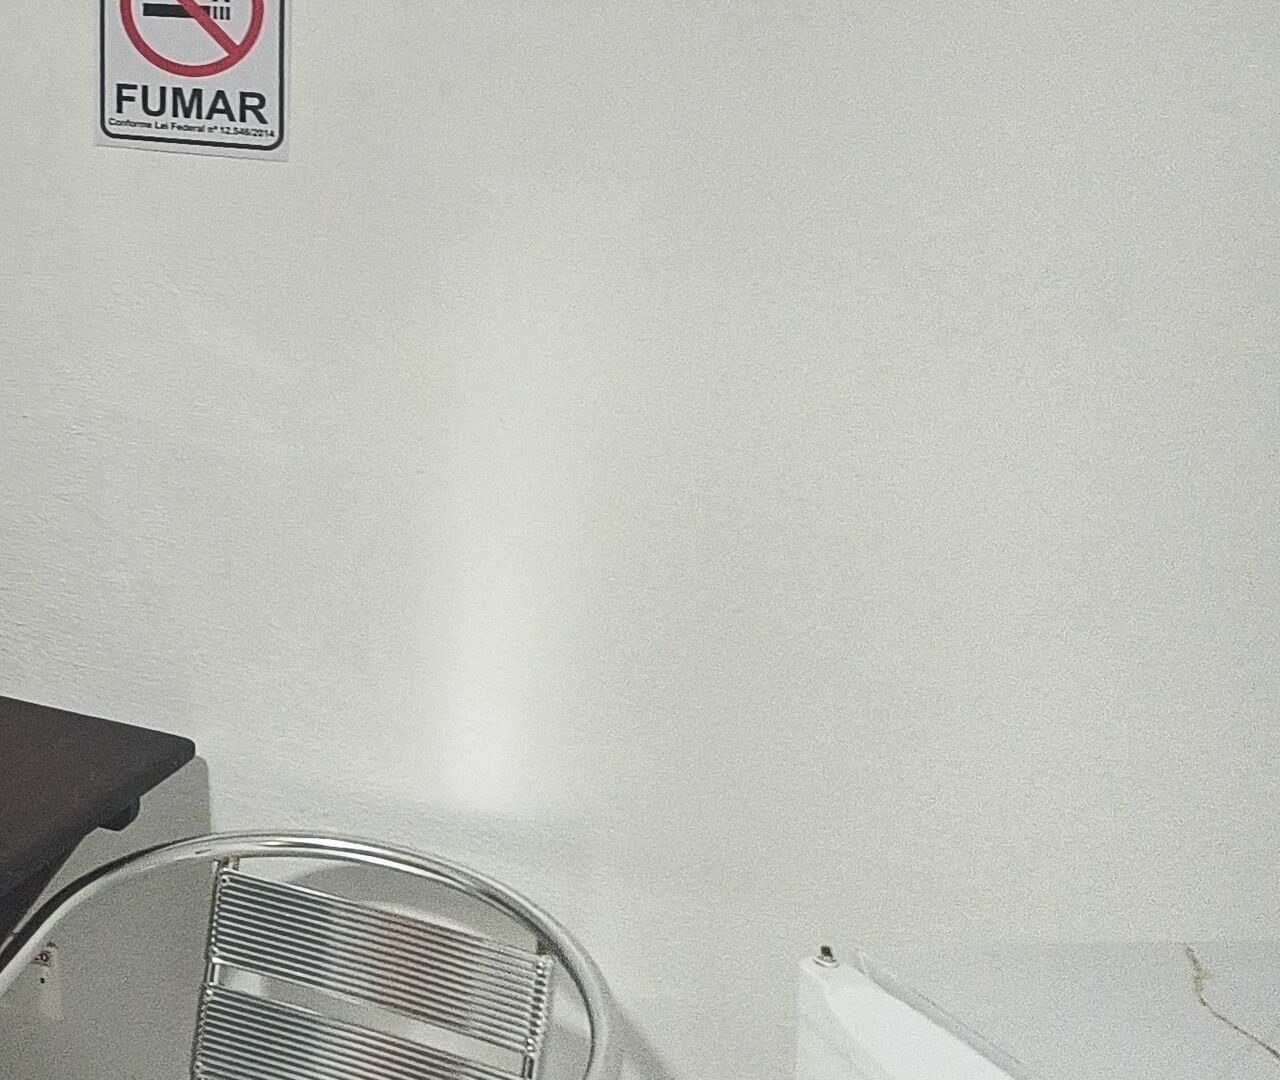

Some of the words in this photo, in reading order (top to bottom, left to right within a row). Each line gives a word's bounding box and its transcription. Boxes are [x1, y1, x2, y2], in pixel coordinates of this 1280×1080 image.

[116, 83, 268, 124] FUMAR
[108, 118, 152, 129] Conforme
[154, 121, 168, 130] Lei
[171, 122, 206, 133] Federal
